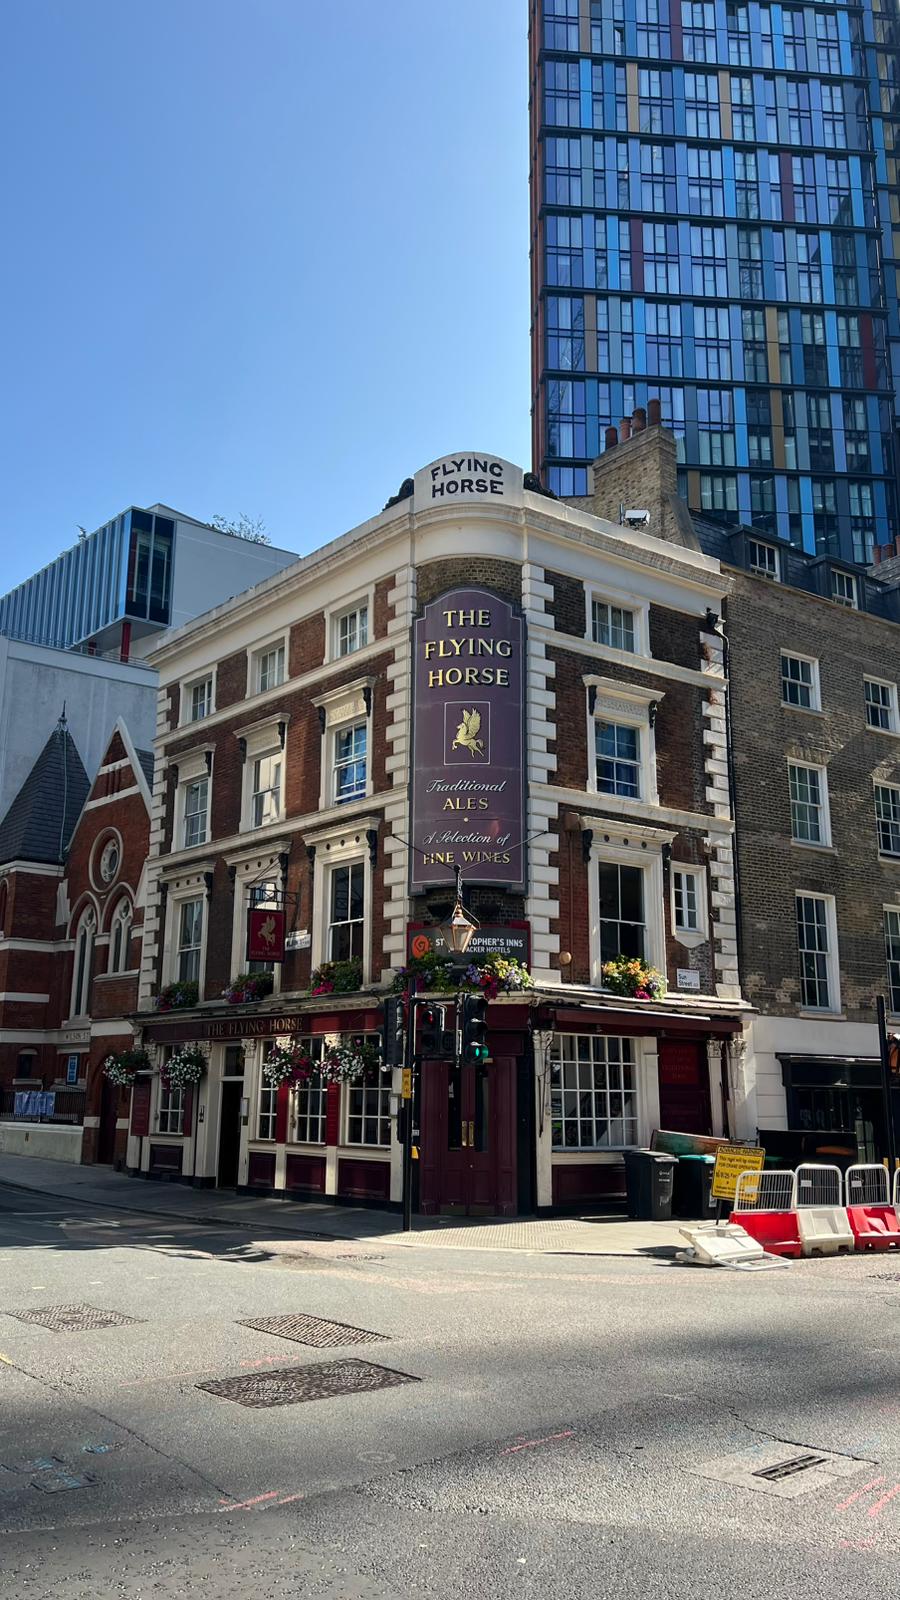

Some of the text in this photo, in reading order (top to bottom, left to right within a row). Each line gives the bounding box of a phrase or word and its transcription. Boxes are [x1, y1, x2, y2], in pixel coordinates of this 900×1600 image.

[430, 458, 504, 481] FLYING
[432, 478, 504, 498] HORSE
[443, 609, 490, 627] THE
[425, 638, 512, 660] FLYING
[428, 667, 509, 688] HORSE
[426, 779, 507, 793] Traditional
[443, 797, 489, 810] ALES
[423, 830, 511, 846] A Selection of
[423, 851, 511, 865] FINE WINES
[435, 937, 524, 948] ST TOPHER'S INNS
[486, 946, 511, 954] HOSTELS
[207, 1017, 303, 1036] THE FLYING HORSE
